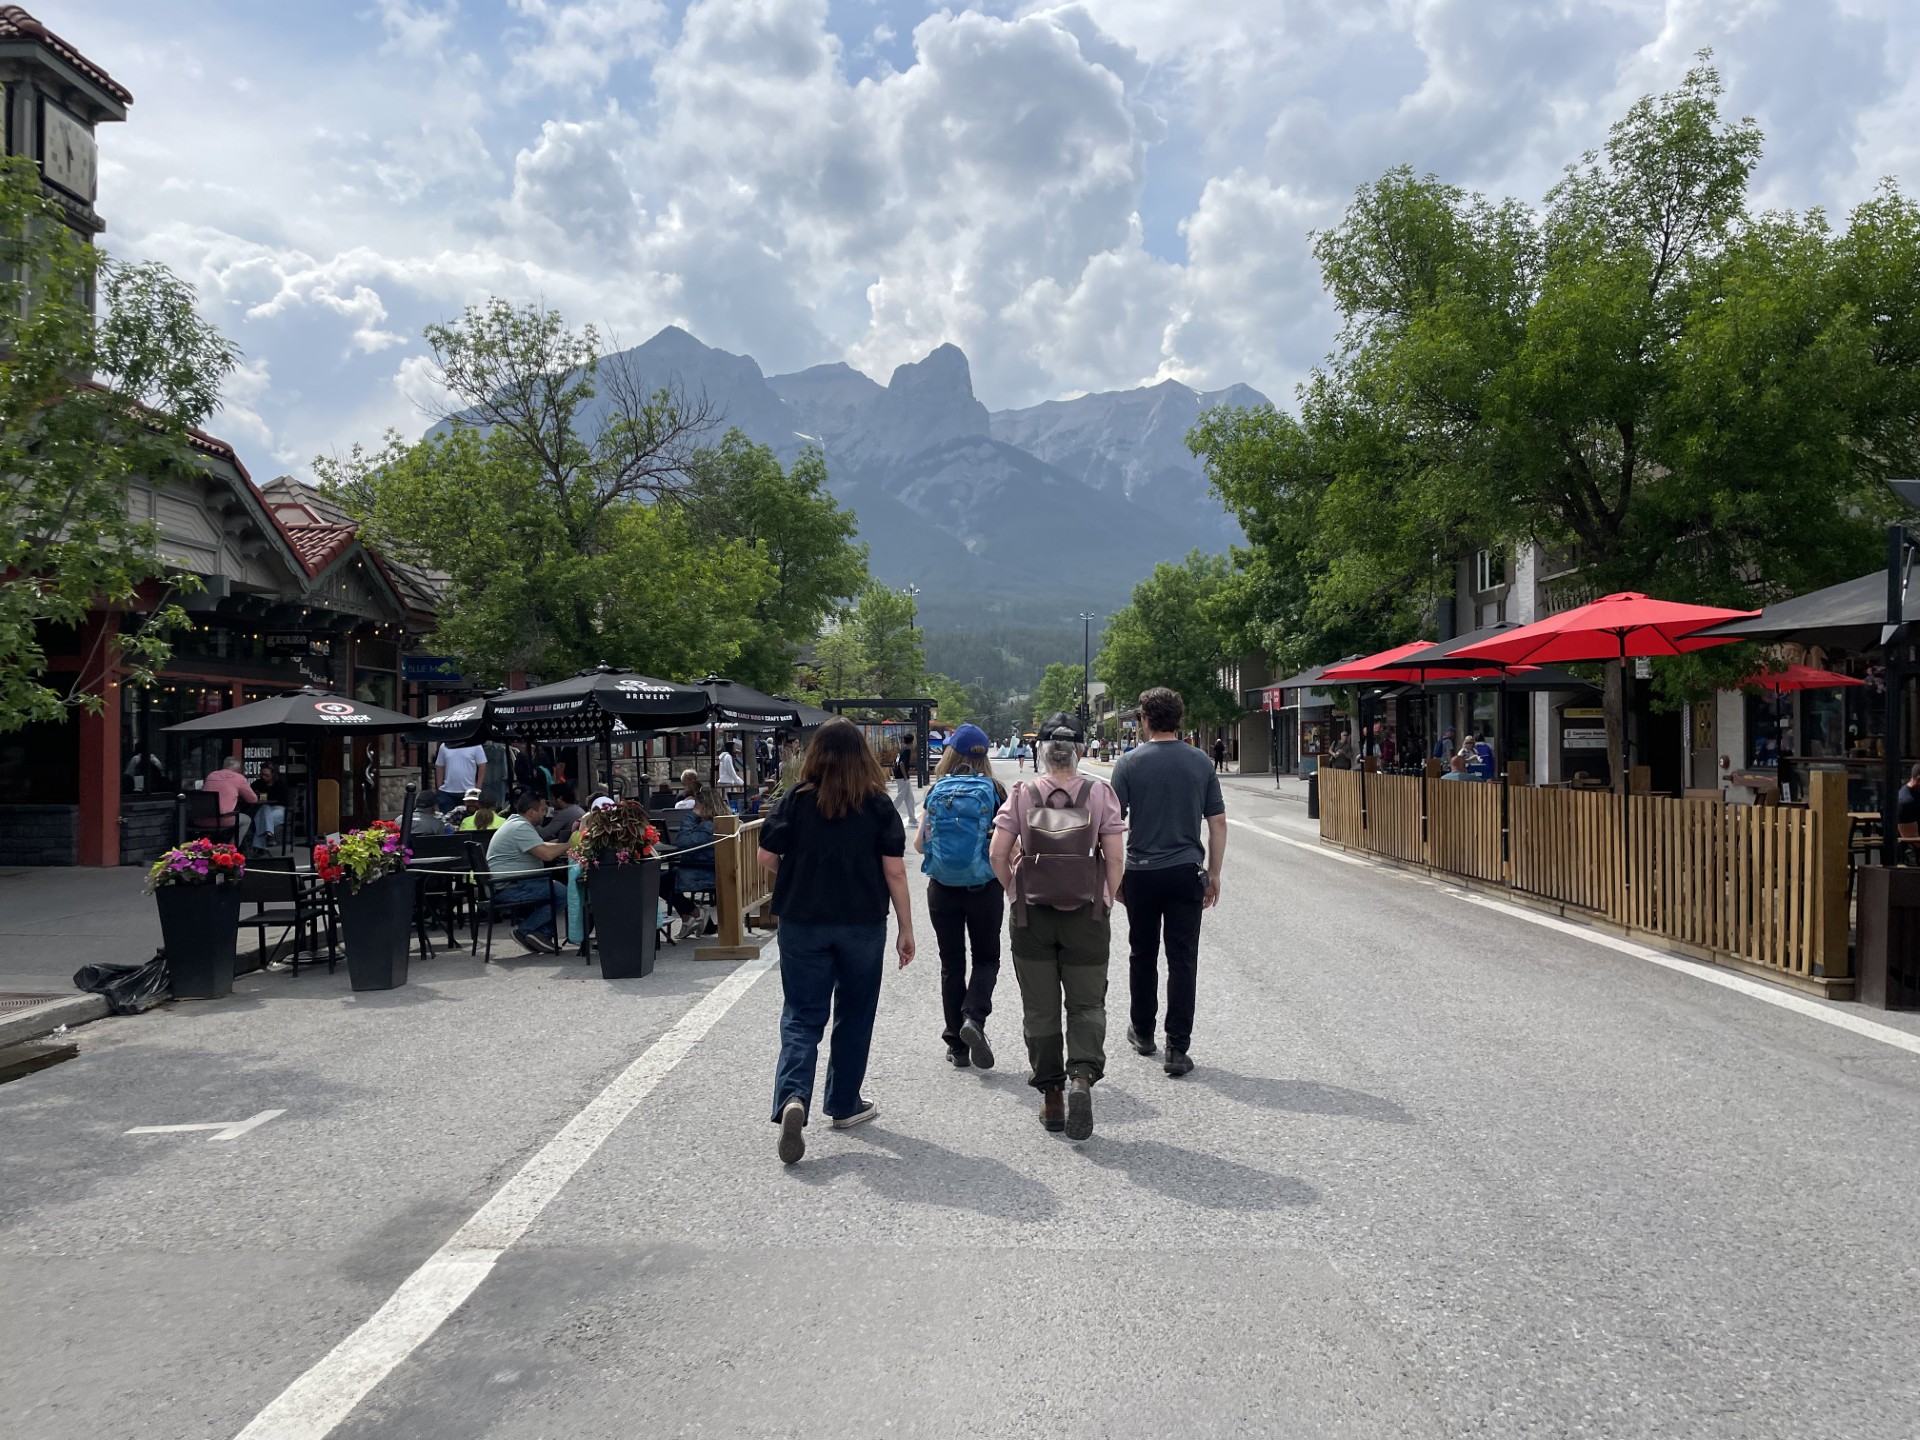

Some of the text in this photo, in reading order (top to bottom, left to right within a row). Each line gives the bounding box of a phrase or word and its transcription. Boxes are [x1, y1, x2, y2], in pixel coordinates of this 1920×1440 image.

[626, 692, 670, 700] BREWERY
[494, 706, 515, 714] PROUD
[516, 705, 533, 713] EARLY
[552, 702, 570, 711] CRAFT
[780, 714, 793, 722] BEER
[244, 747, 272, 759] BREAKFAST
[244, 761, 264, 775] SEVE
